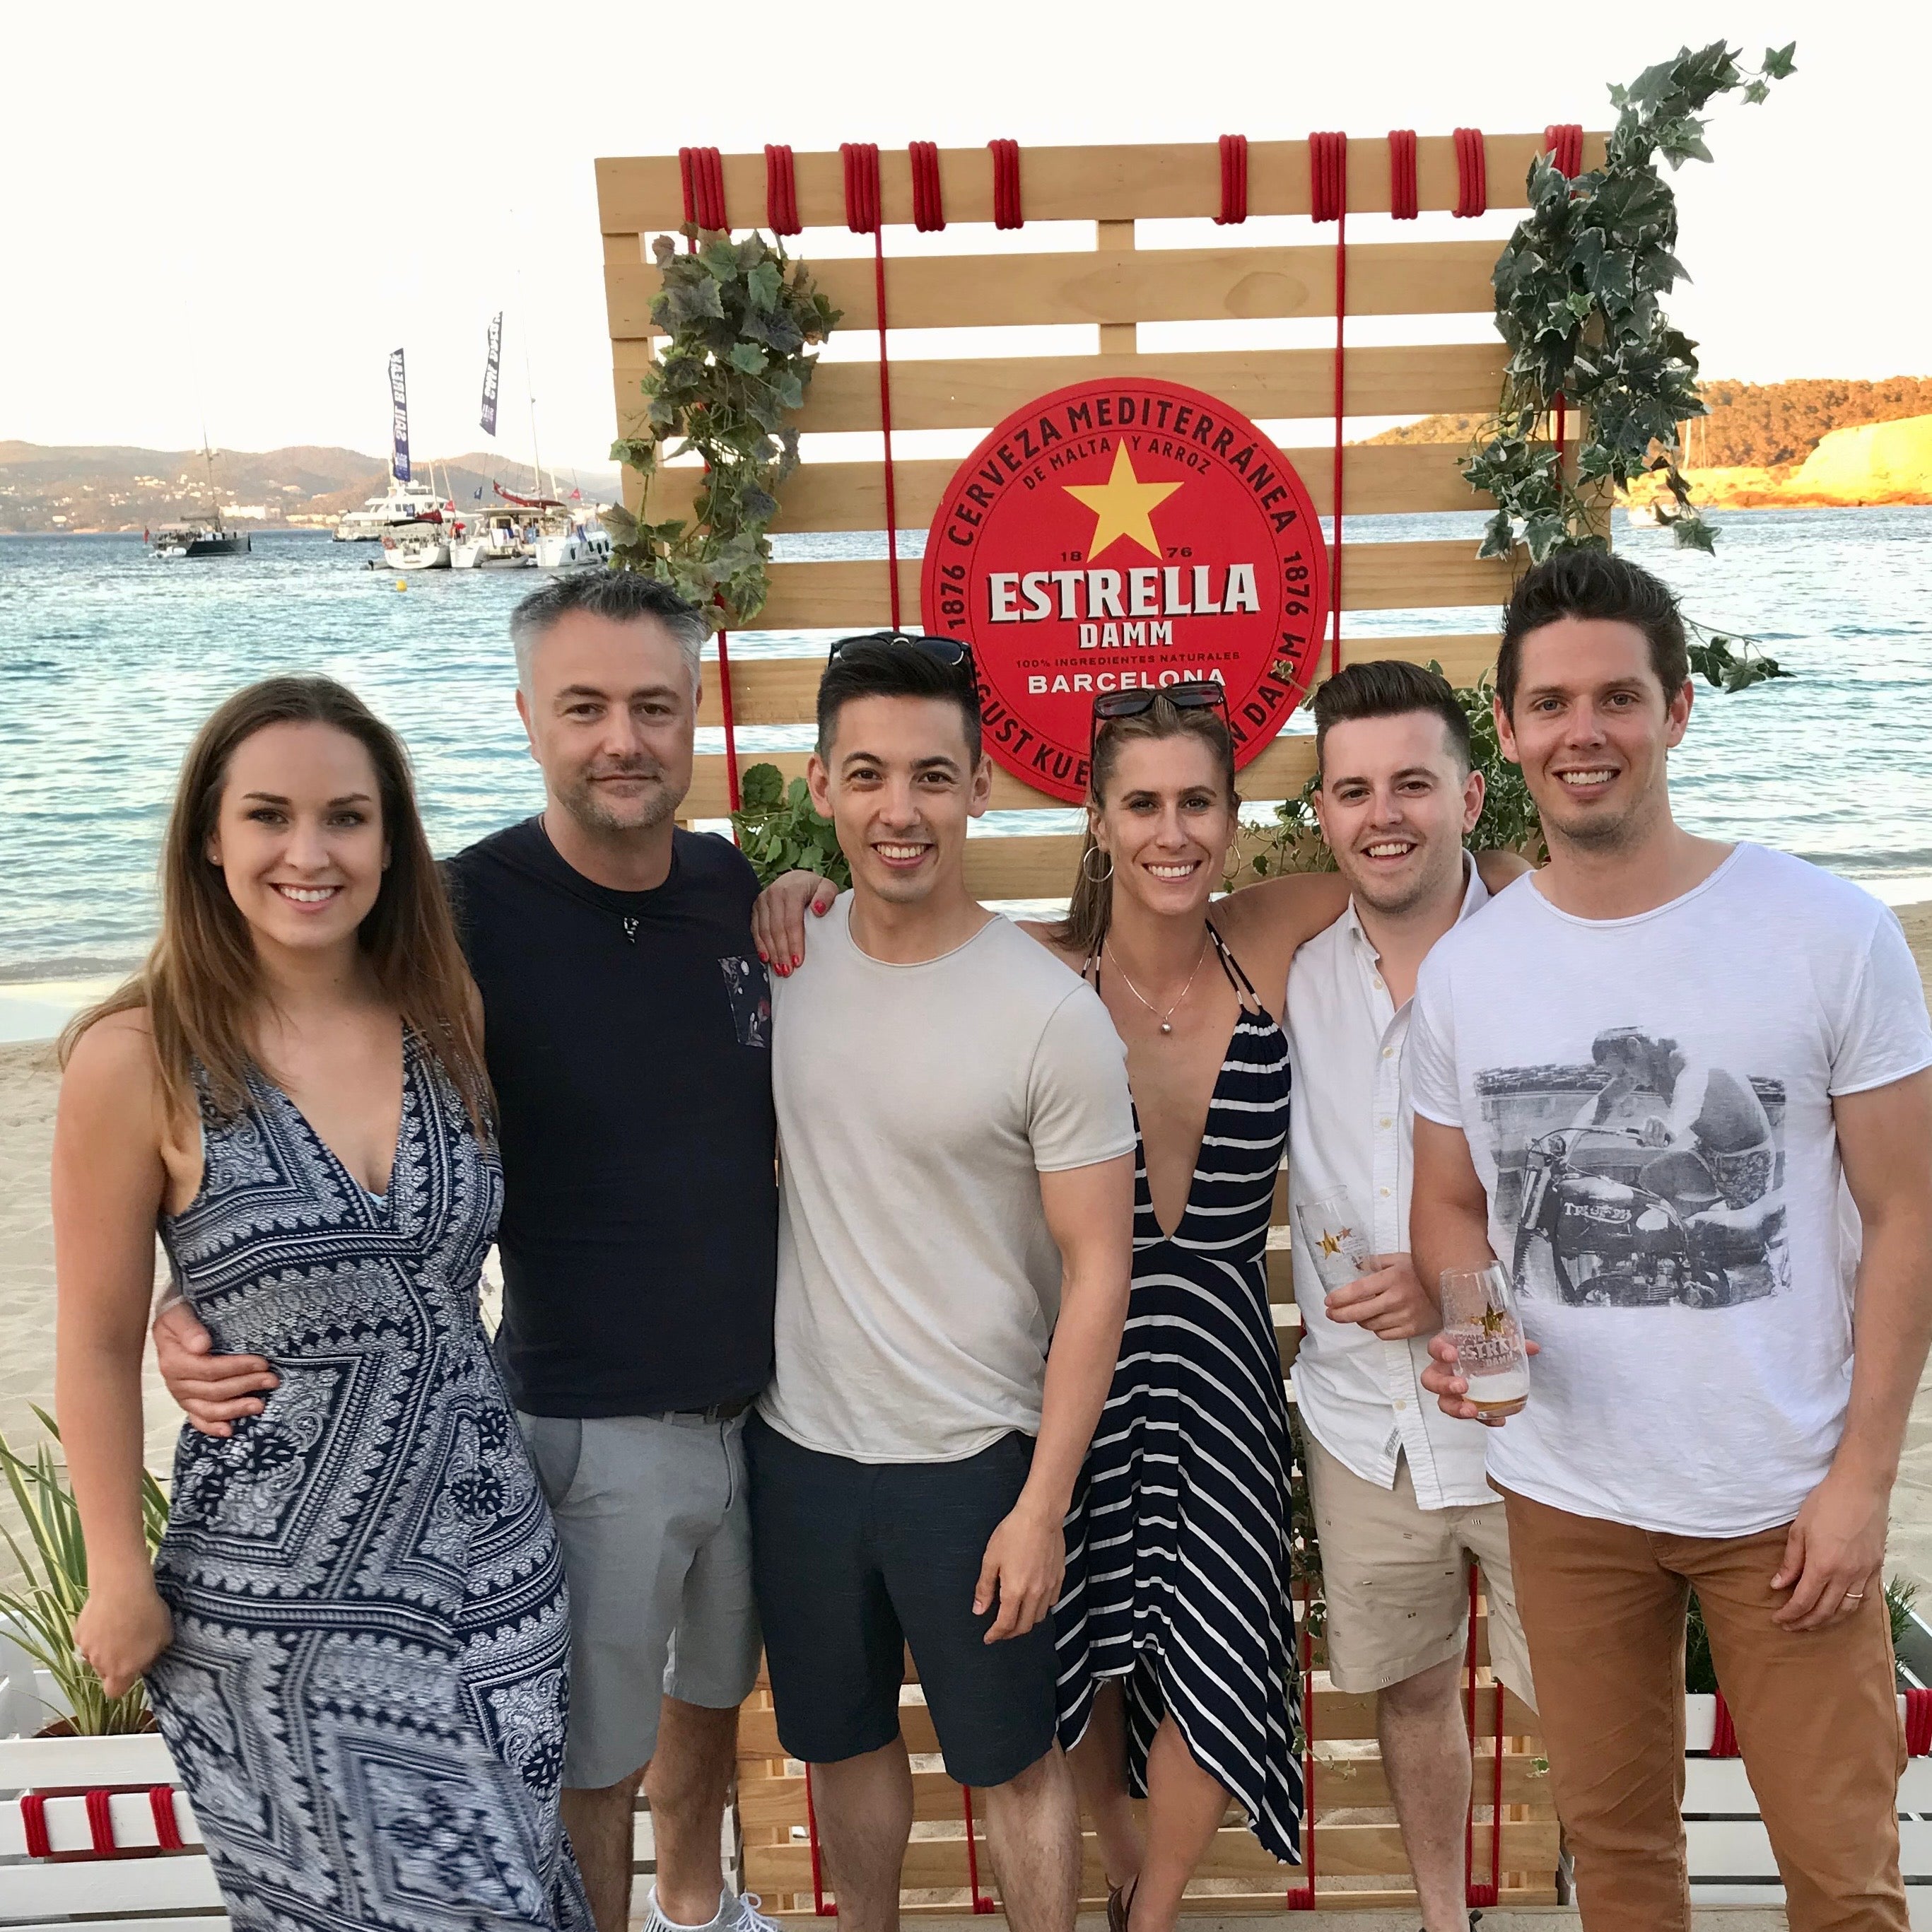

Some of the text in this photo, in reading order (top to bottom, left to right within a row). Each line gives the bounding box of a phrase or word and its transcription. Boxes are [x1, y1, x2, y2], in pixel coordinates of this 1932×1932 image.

[1022, 435, 1212, 491] DE MALTA Y ARROZ
[940, 397, 1310, 630] 1876 CERVEZA MEDITERRÁNEA 1876
[1061, 546, 1193, 563] 18 76
[988, 563, 1261, 624] ESTRELLA
[1078, 620, 1173, 649] DAMM
[1016, 650, 1241, 669] 100% INGREDIENTES NATURALES
[1027, 667, 1226, 695] BARCELONA
[974, 660, 1034, 754] GUST
